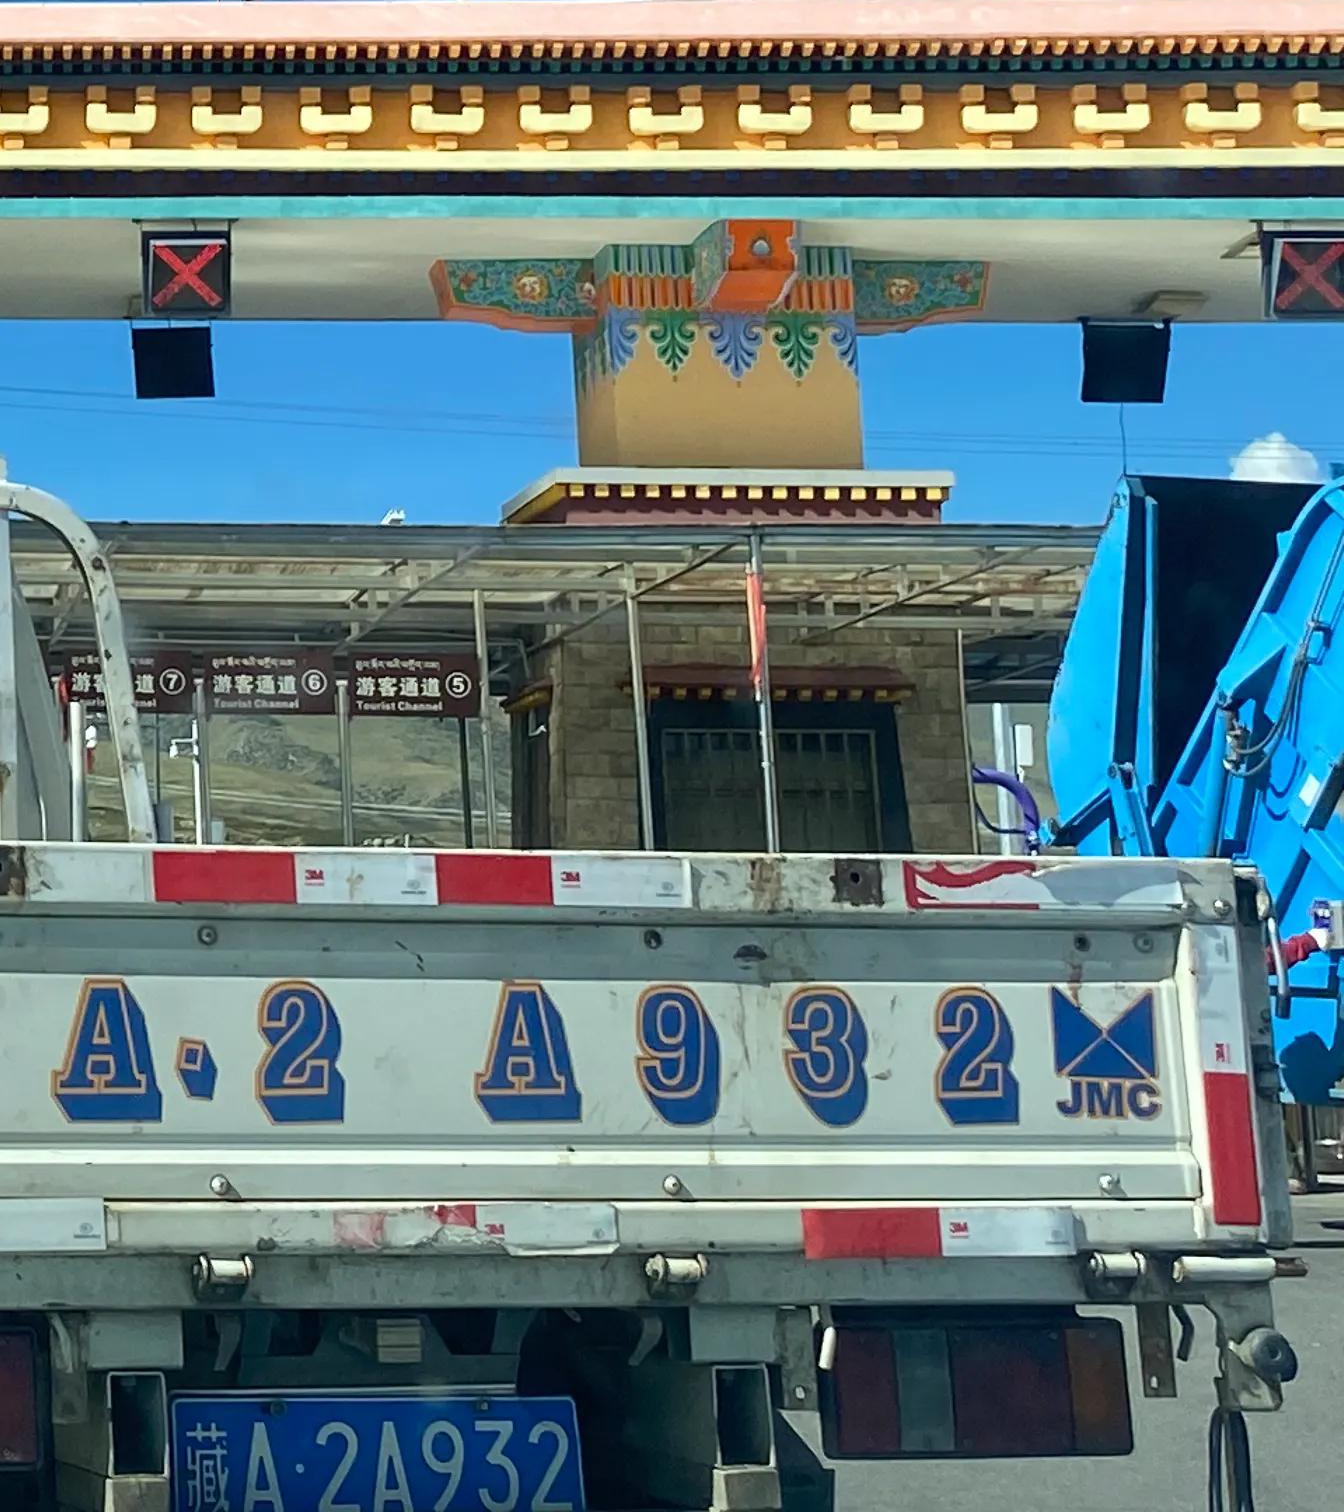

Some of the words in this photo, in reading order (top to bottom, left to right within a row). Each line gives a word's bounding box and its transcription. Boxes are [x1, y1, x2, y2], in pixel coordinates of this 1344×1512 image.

[213, 674, 297, 694] 游客通道
[356, 676, 441, 697] 游客通道
[213, 699, 252, 709] Tourist
[254, 699, 300, 709] Channel
[356, 701, 396, 711] Tourist
[398, 701, 443, 711] Channel
[1056, 1078, 1162, 1120] JMC
